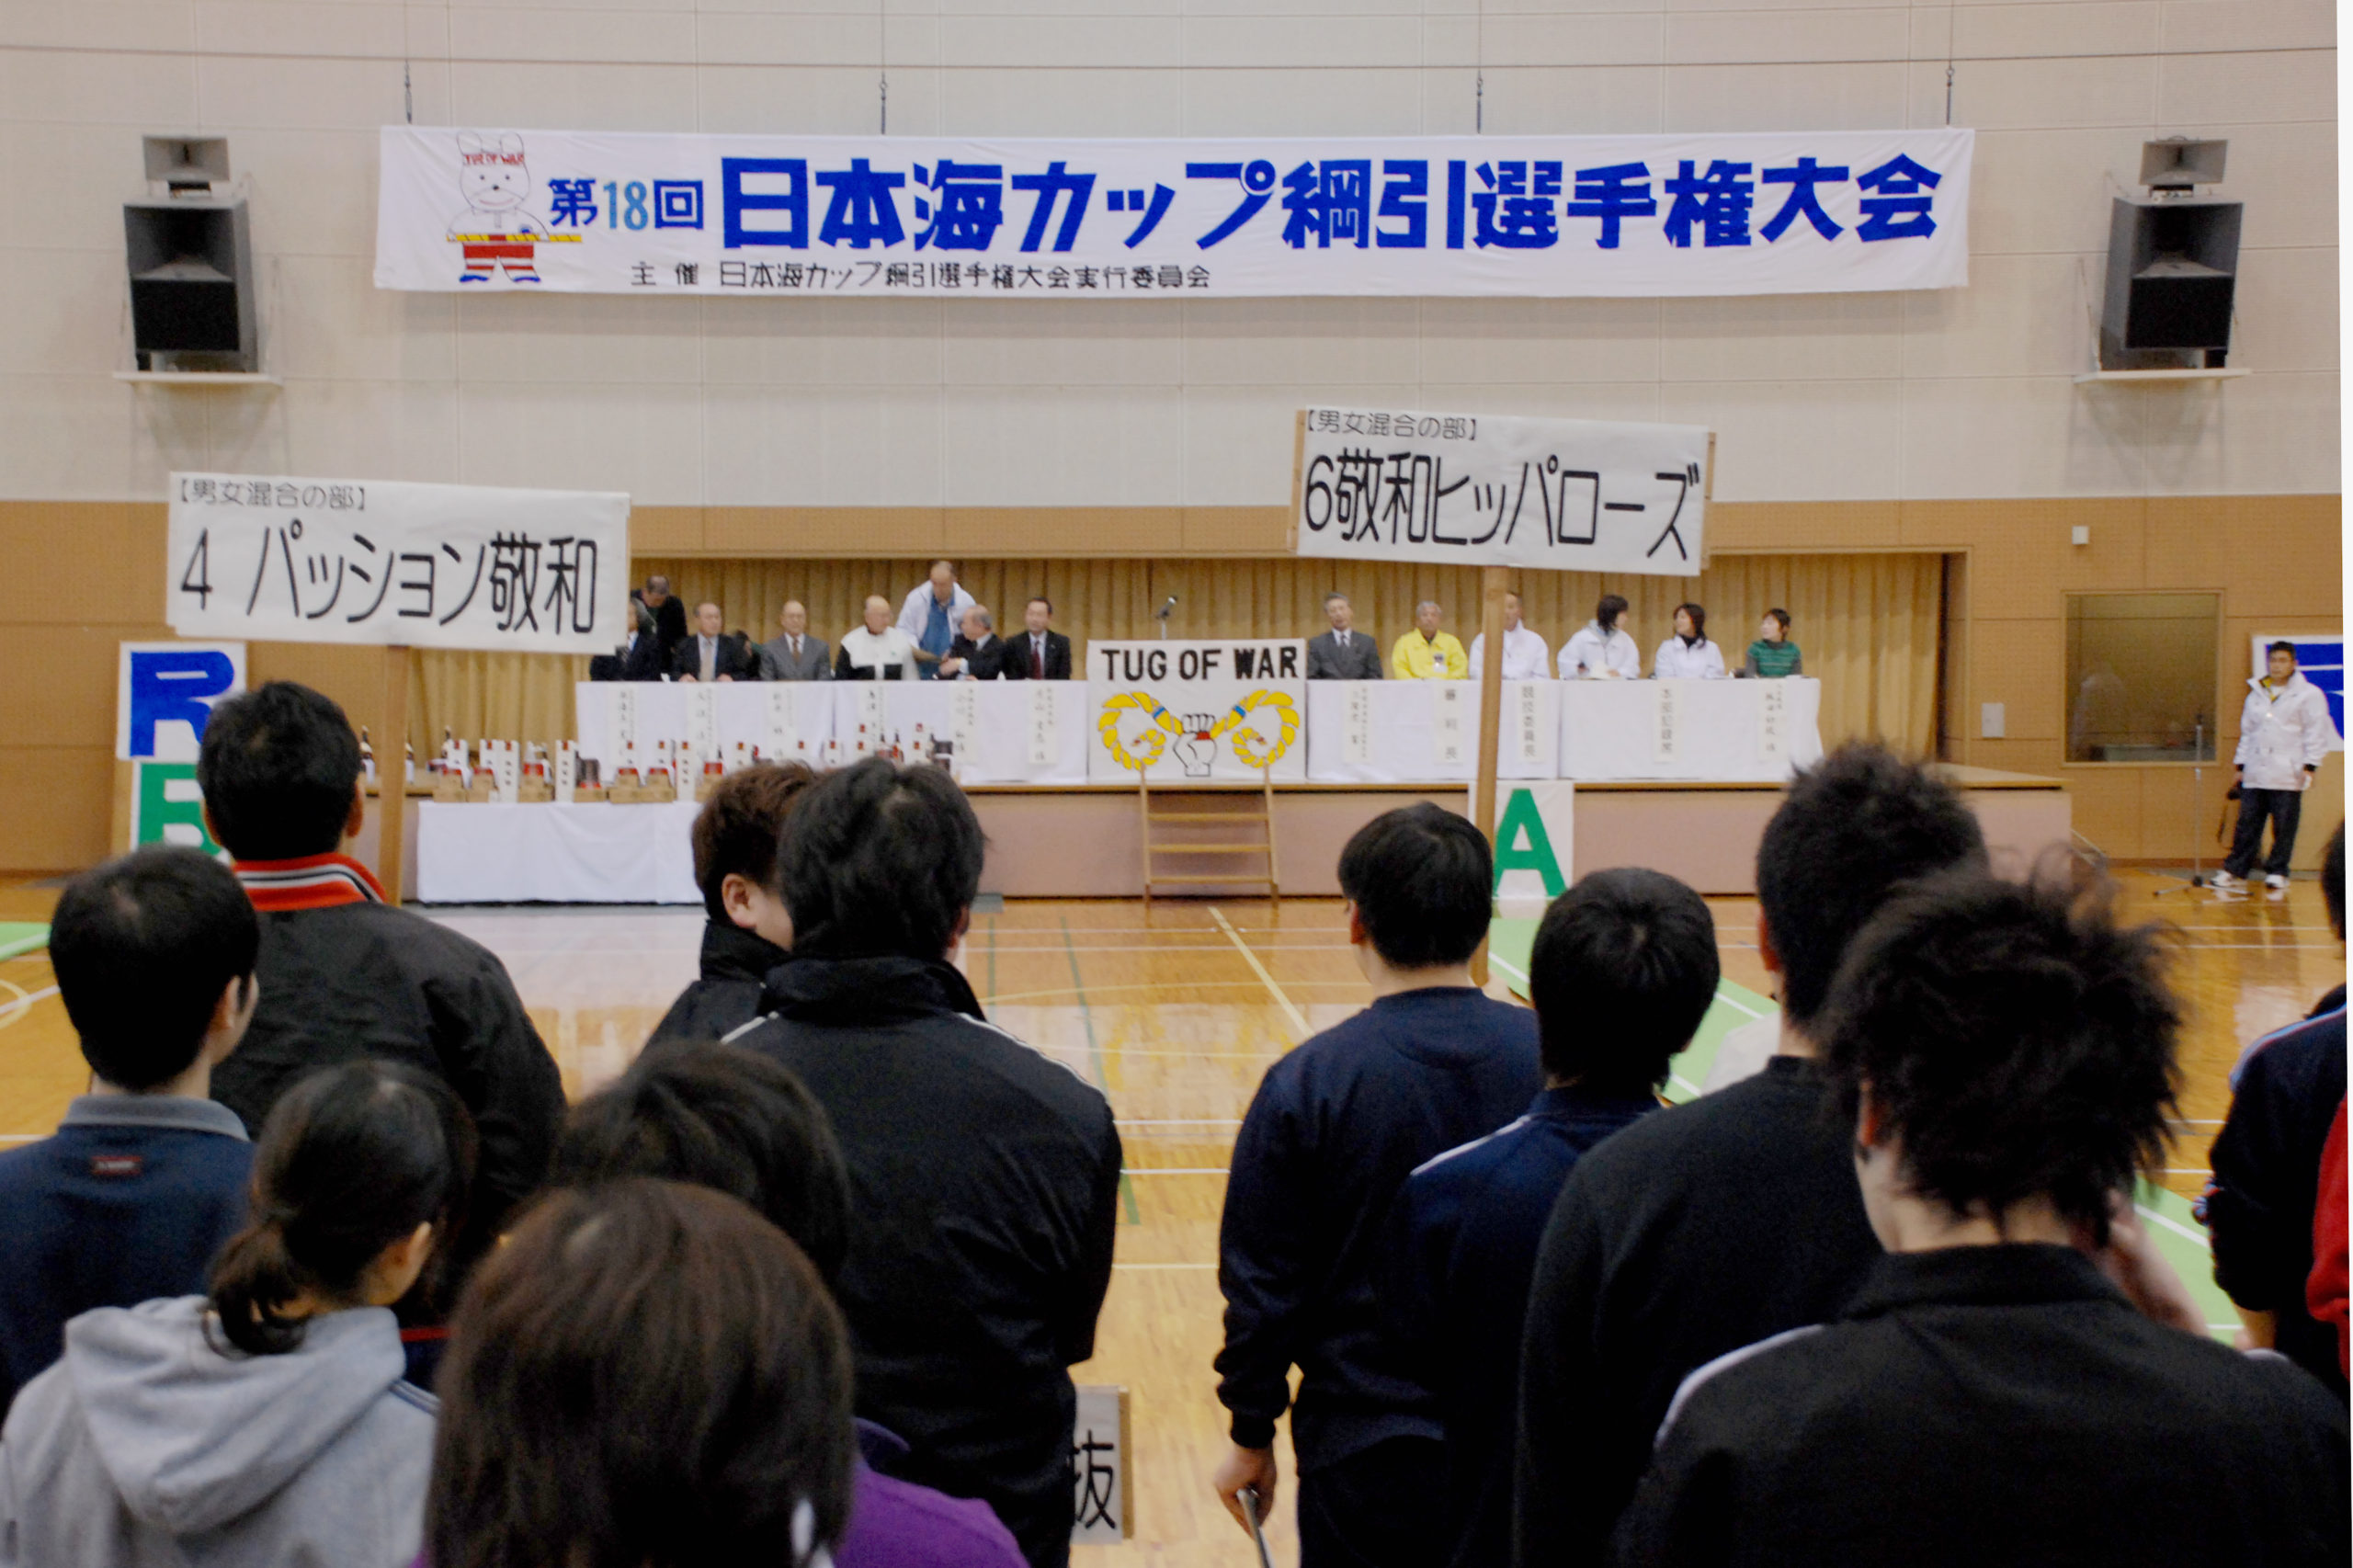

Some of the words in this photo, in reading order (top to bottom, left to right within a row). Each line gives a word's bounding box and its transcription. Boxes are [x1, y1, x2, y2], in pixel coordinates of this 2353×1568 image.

[548, 177, 704, 230] 第18回
[722, 153, 1943, 252] 日本海カップ綱引選手権大会
[1307, 409, 1476, 441] 【男女混合の部】
[178, 478, 366, 511] 【男女混合の部】
[180, 528, 212, 611] 4
[246, 518, 597, 634] パッション敬和
[130, 651, 234, 757] R
[1101, 649, 1167, 681] TUG
[1179, 649, 1222, 680] OF
[1233, 646, 1298, 679] WAR
[1493, 788, 1567, 897] A
